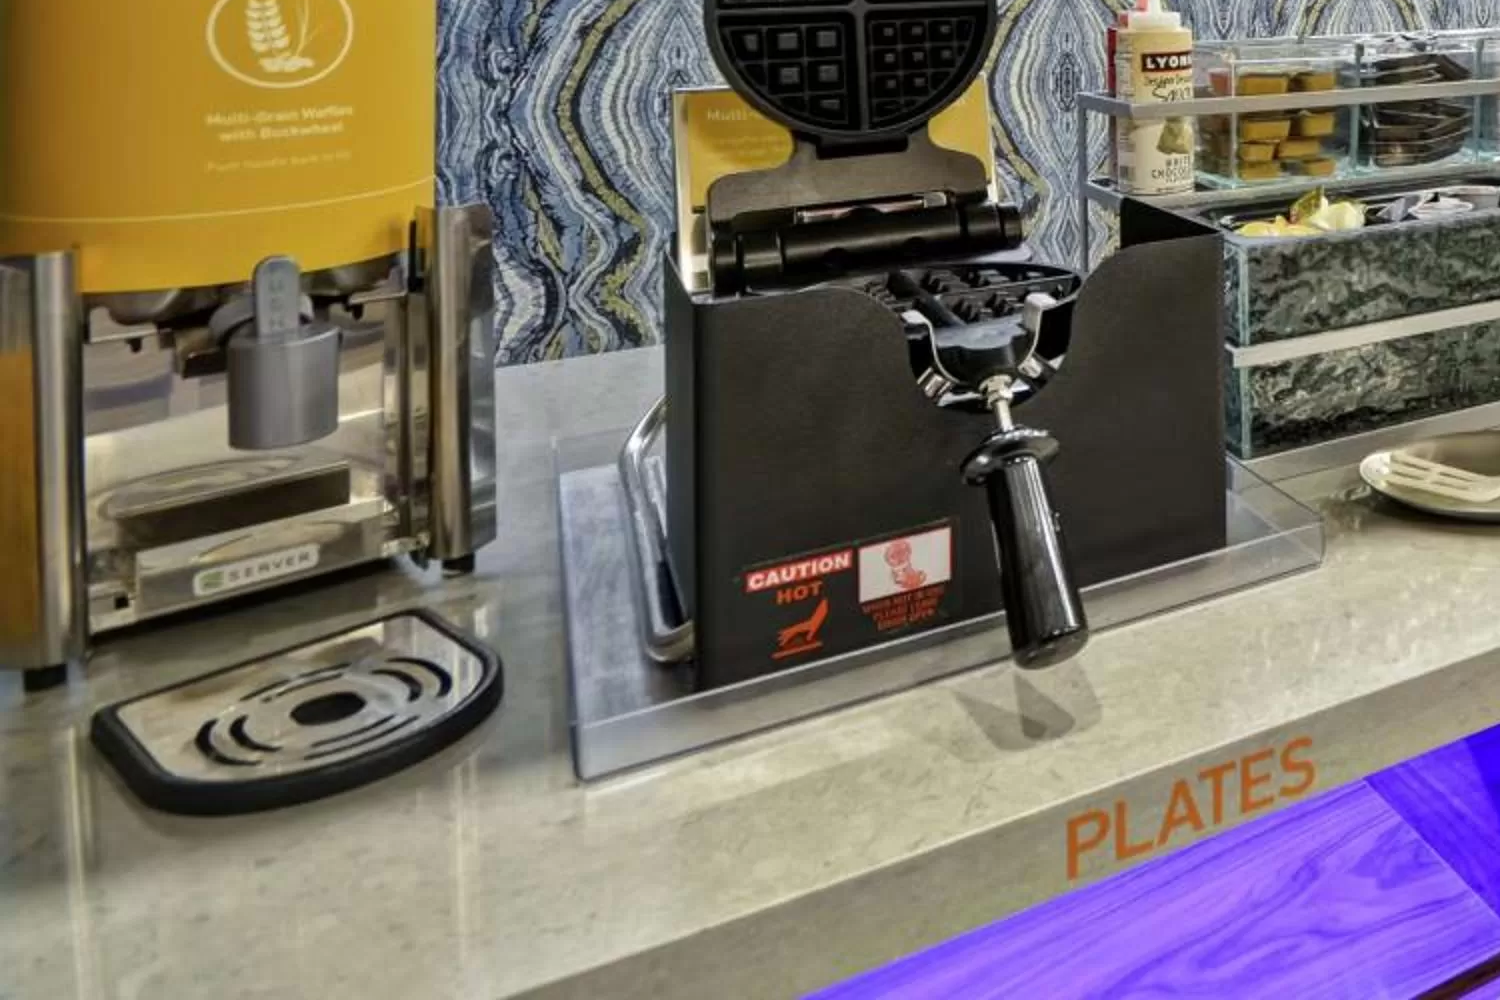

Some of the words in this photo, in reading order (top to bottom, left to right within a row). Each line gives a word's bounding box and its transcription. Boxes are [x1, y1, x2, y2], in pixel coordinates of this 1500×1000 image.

[228, 551, 310, 582] SERVER
[748, 552, 851, 590] CAUTION
[775, 579, 823, 604] HOT
[1065, 735, 1316, 881] PLATES
